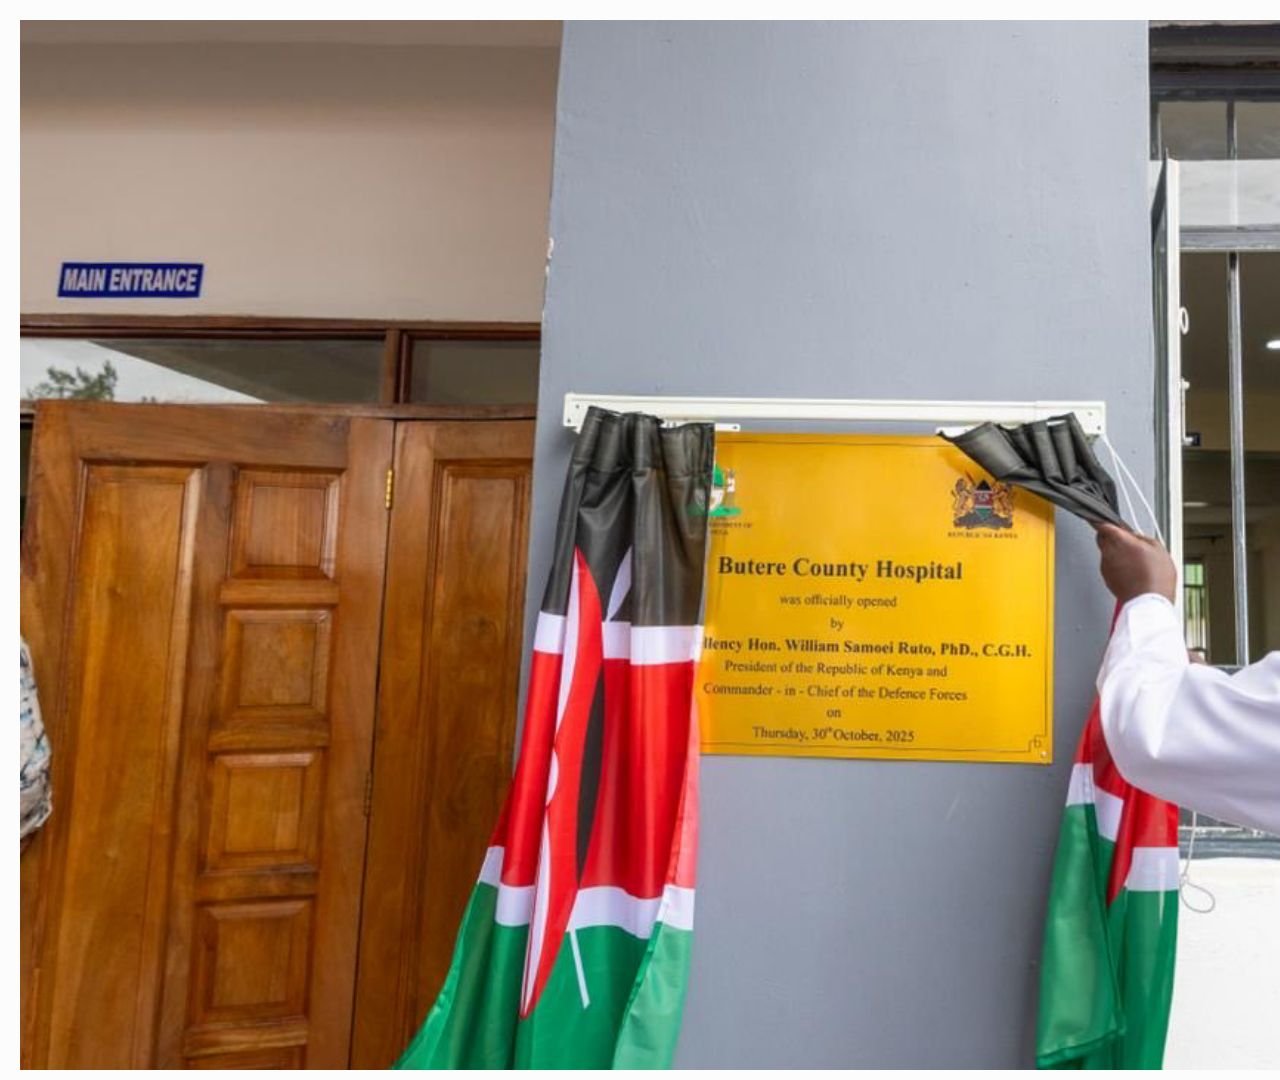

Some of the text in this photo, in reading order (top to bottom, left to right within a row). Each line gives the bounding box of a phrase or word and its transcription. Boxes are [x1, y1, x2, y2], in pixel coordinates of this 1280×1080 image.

[63, 268, 197, 292] MAIN ENTRANCE
[718, 556, 963, 583] Butere County Hospital
[780, 593, 897, 610] was officially opened
[830, 618, 844, 630] by
[748, 638, 781, 652] Hon.
[786, 639, 839, 653] William
[844, 640, 894, 654] Samoei
[898, 641, 936, 656] Ruto,
[941, 642, 978, 658] PhD.,
[982, 644, 1032, 658] C.G.H.
[725, 660, 948, 679] President of the Republic of Kenya and
[703, 682, 773, 696] Commander
[784, 684, 796, 696] in
[808, 685, 838, 698] Chief
[840, 685, 854, 698] of
[858, 686, 875, 698] the
[879, 688, 925, 700] Defence
[930, 689, 967, 701] Forces
[827, 708, 841, 718] on
[752, 726, 809, 742] Thursday,
[886, 730, 914, 742] 2025
